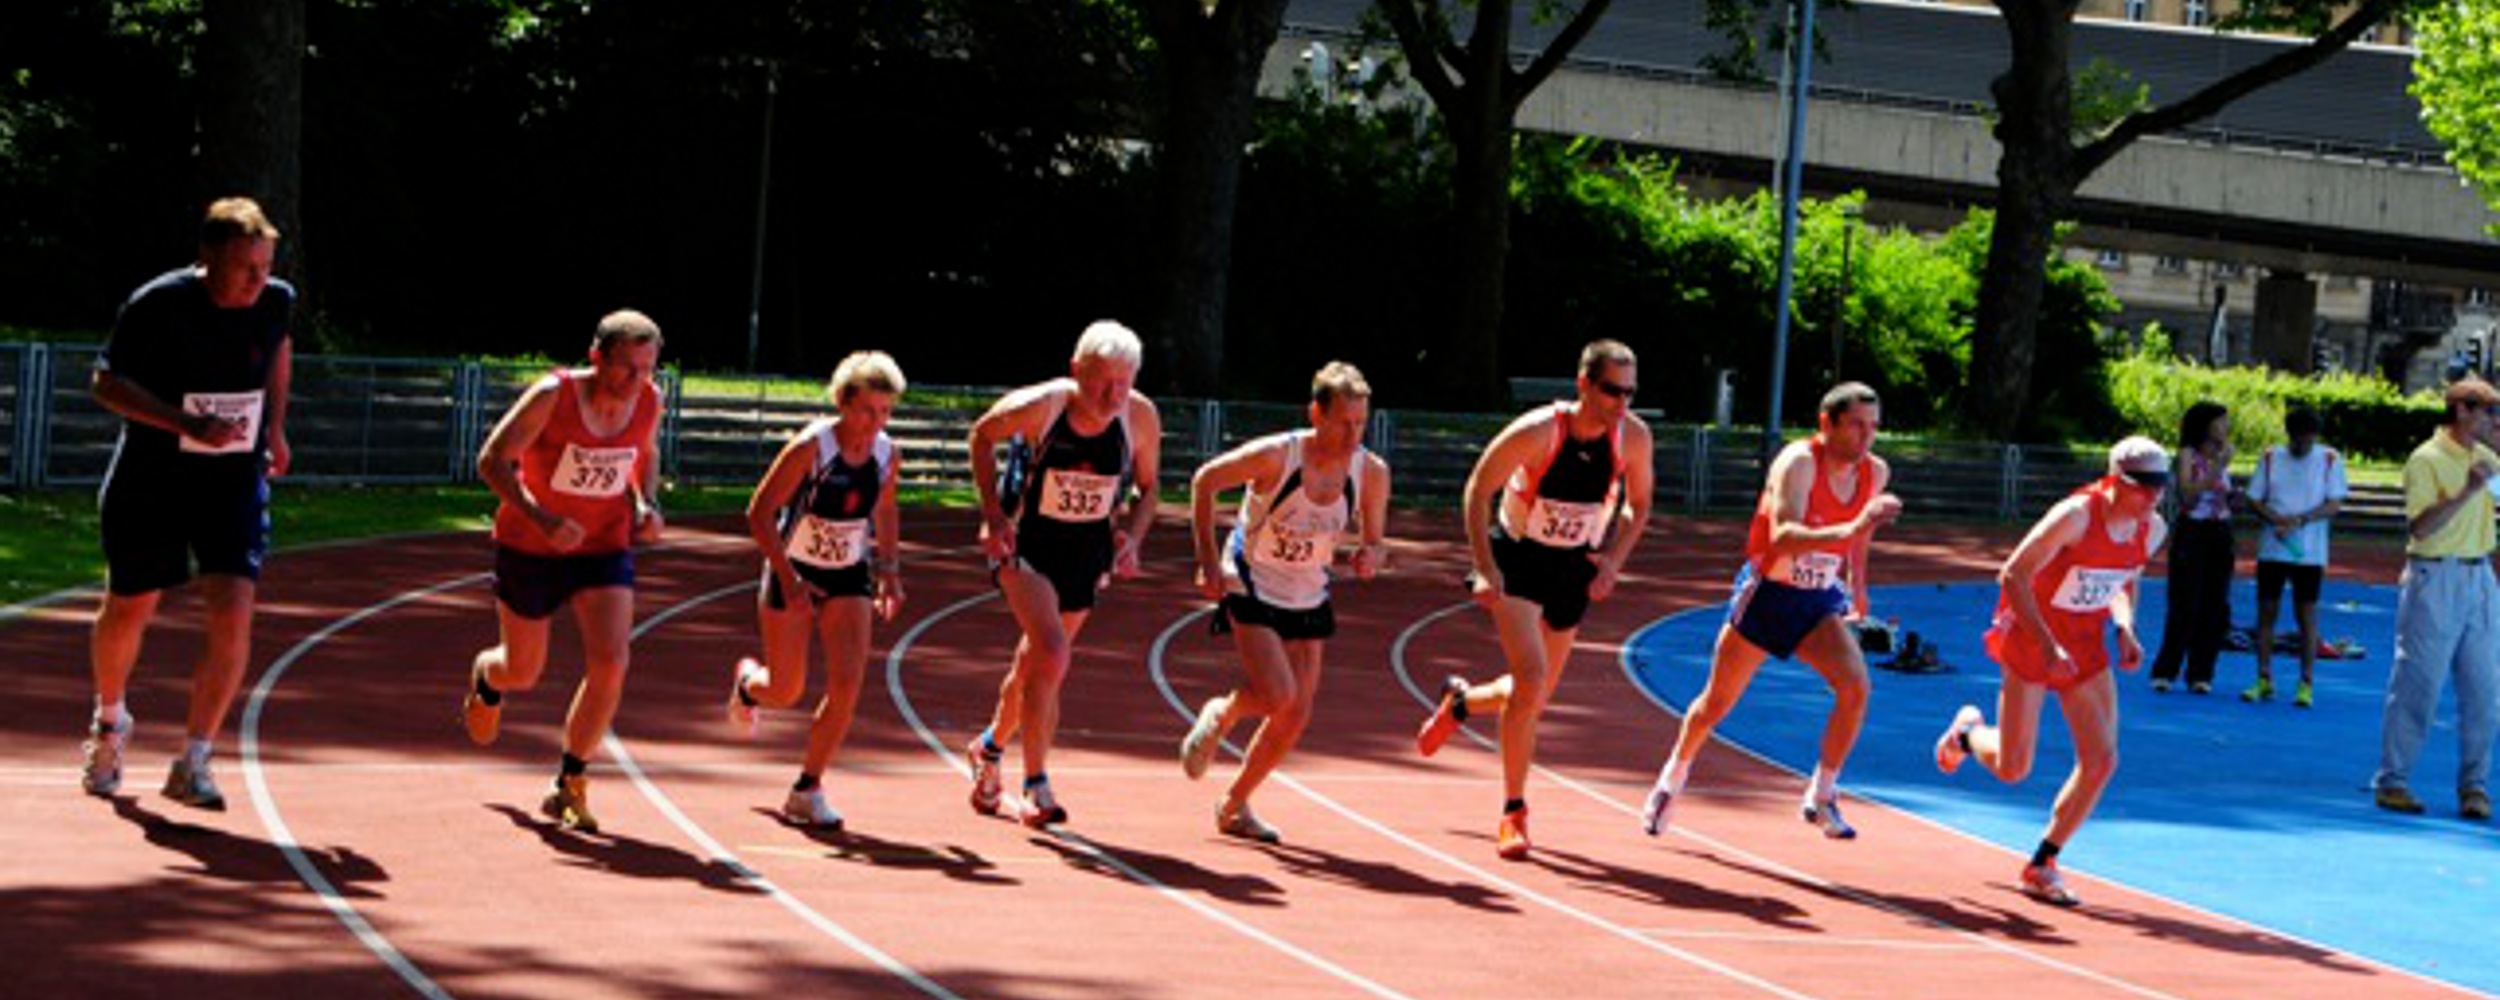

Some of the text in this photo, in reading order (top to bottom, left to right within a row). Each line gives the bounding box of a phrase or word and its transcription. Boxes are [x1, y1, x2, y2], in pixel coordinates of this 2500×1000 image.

[569, 466, 618, 490] 379
[1057, 489, 1103, 514] 332
[1541, 517, 1585, 541] 342
